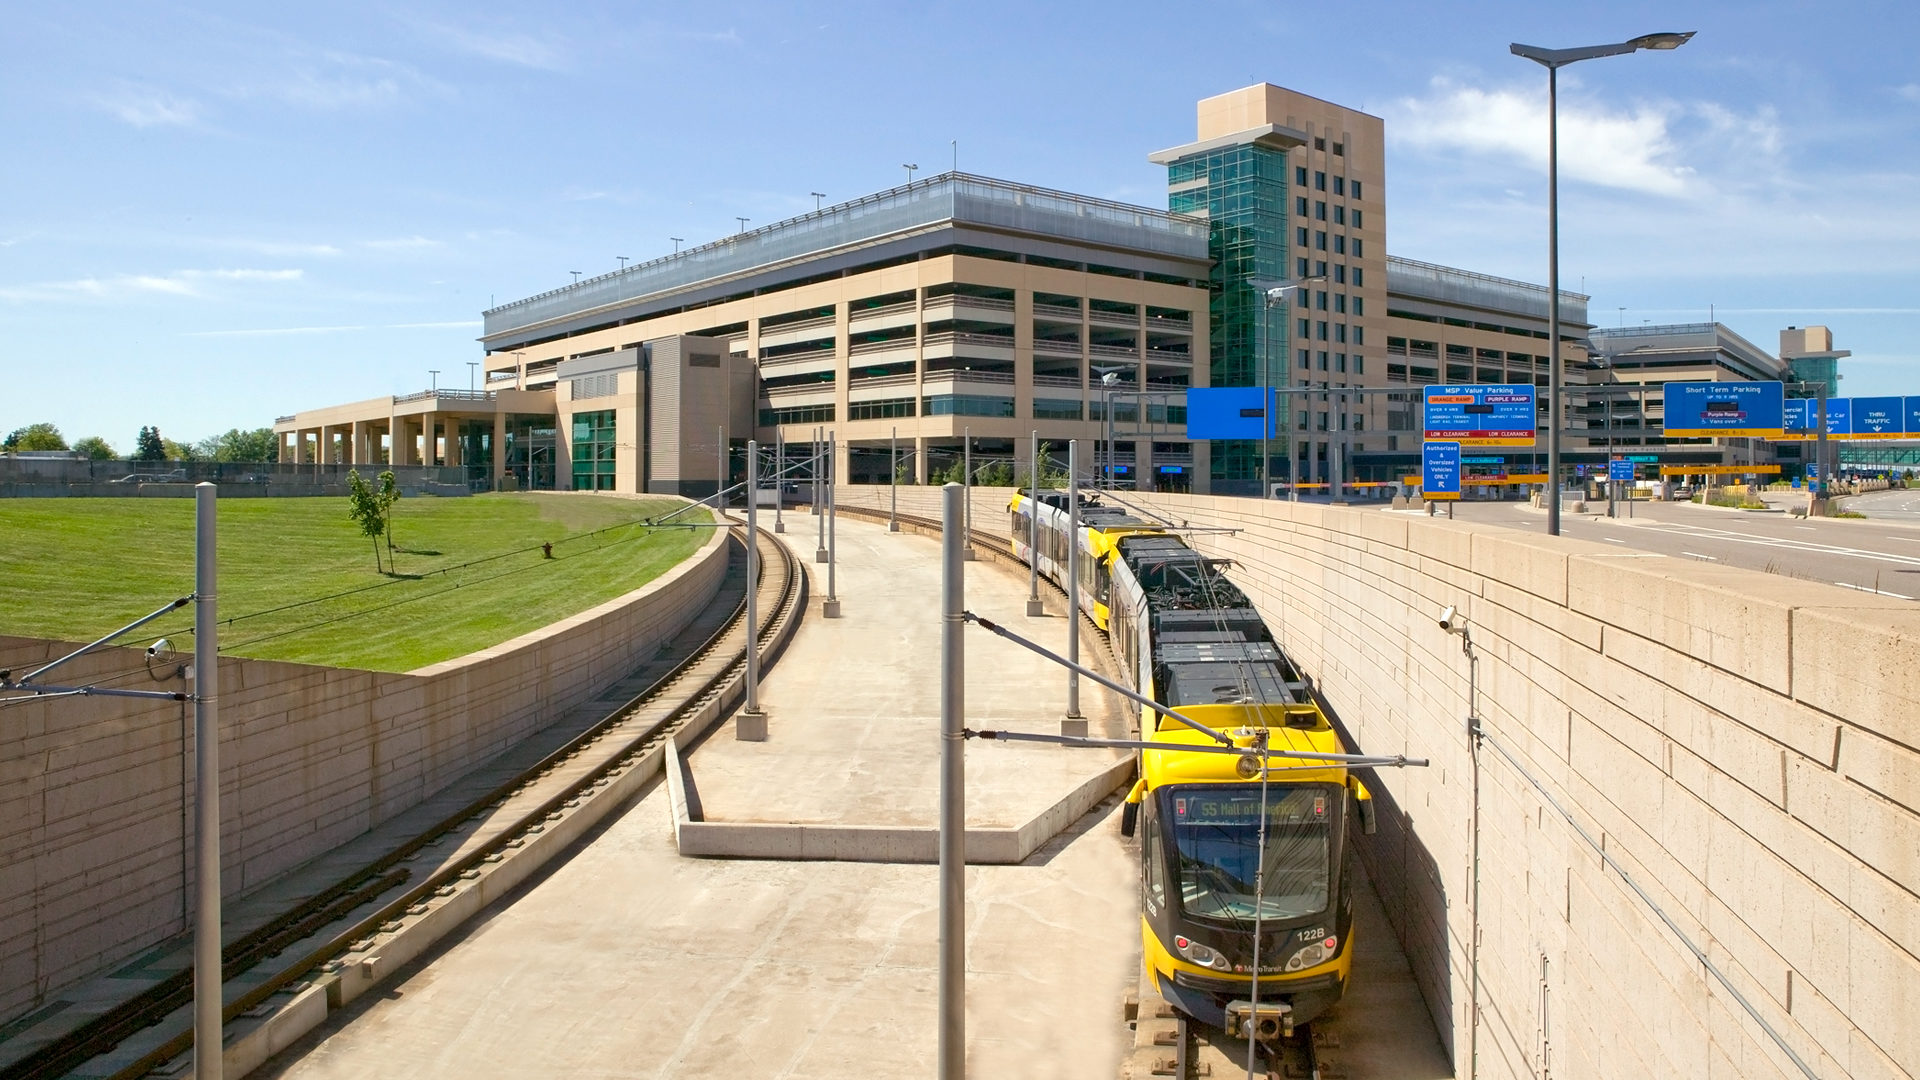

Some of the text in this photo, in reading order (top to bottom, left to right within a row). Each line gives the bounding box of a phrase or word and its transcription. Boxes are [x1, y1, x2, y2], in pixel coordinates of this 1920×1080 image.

[1487, 387, 1514, 395] Parking
[1732, 386, 1761, 394] Parking
[1202, 803, 1217, 816] 55
[1220, 802, 1240, 816] Mall
[1243, 802, 1254, 816] of
[1297, 927, 1325, 942] 122B
